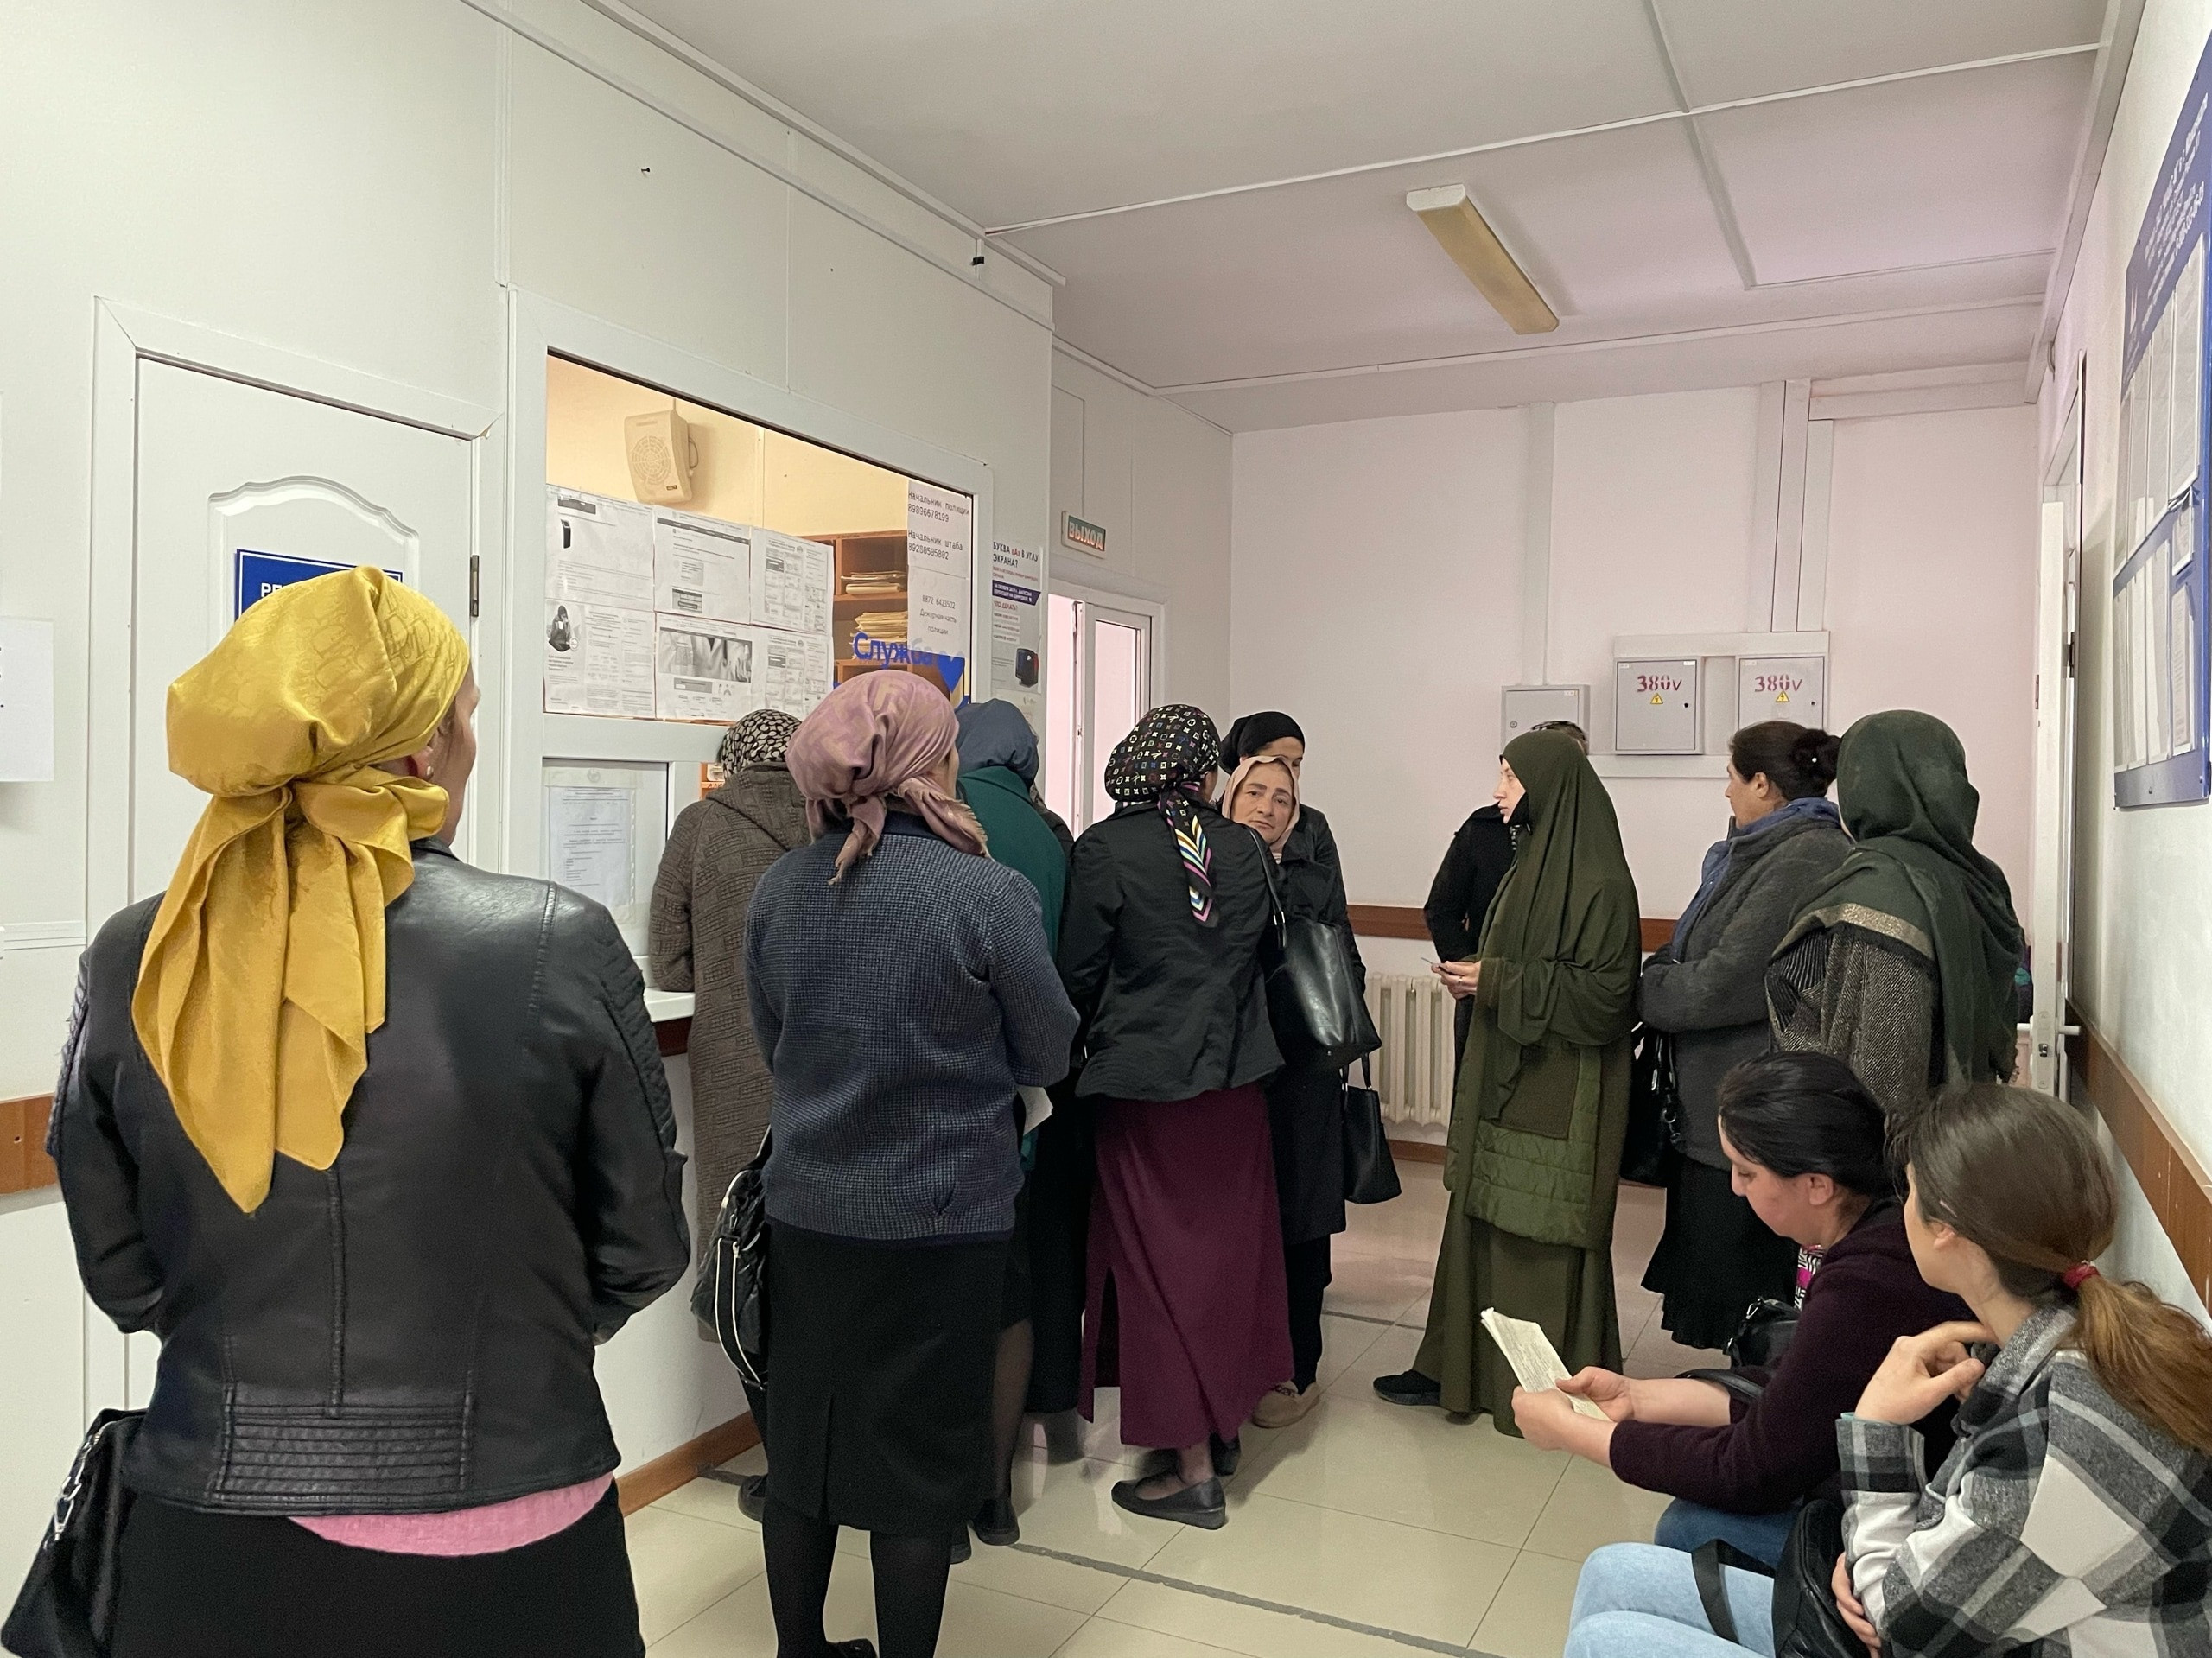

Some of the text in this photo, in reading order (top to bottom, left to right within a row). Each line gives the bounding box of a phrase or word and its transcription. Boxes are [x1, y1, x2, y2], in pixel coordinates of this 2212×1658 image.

[908, 491, 942, 507] Начальник
[909, 530, 963, 551] Начальник штаба
[1069, 522, 1103, 550] ВЫХОД
[993, 541, 1010, 554] БУКВА
[1026, 551, 1039, 562] УГЛУ
[993, 553, 1018, 568] ЭКРАНА?
